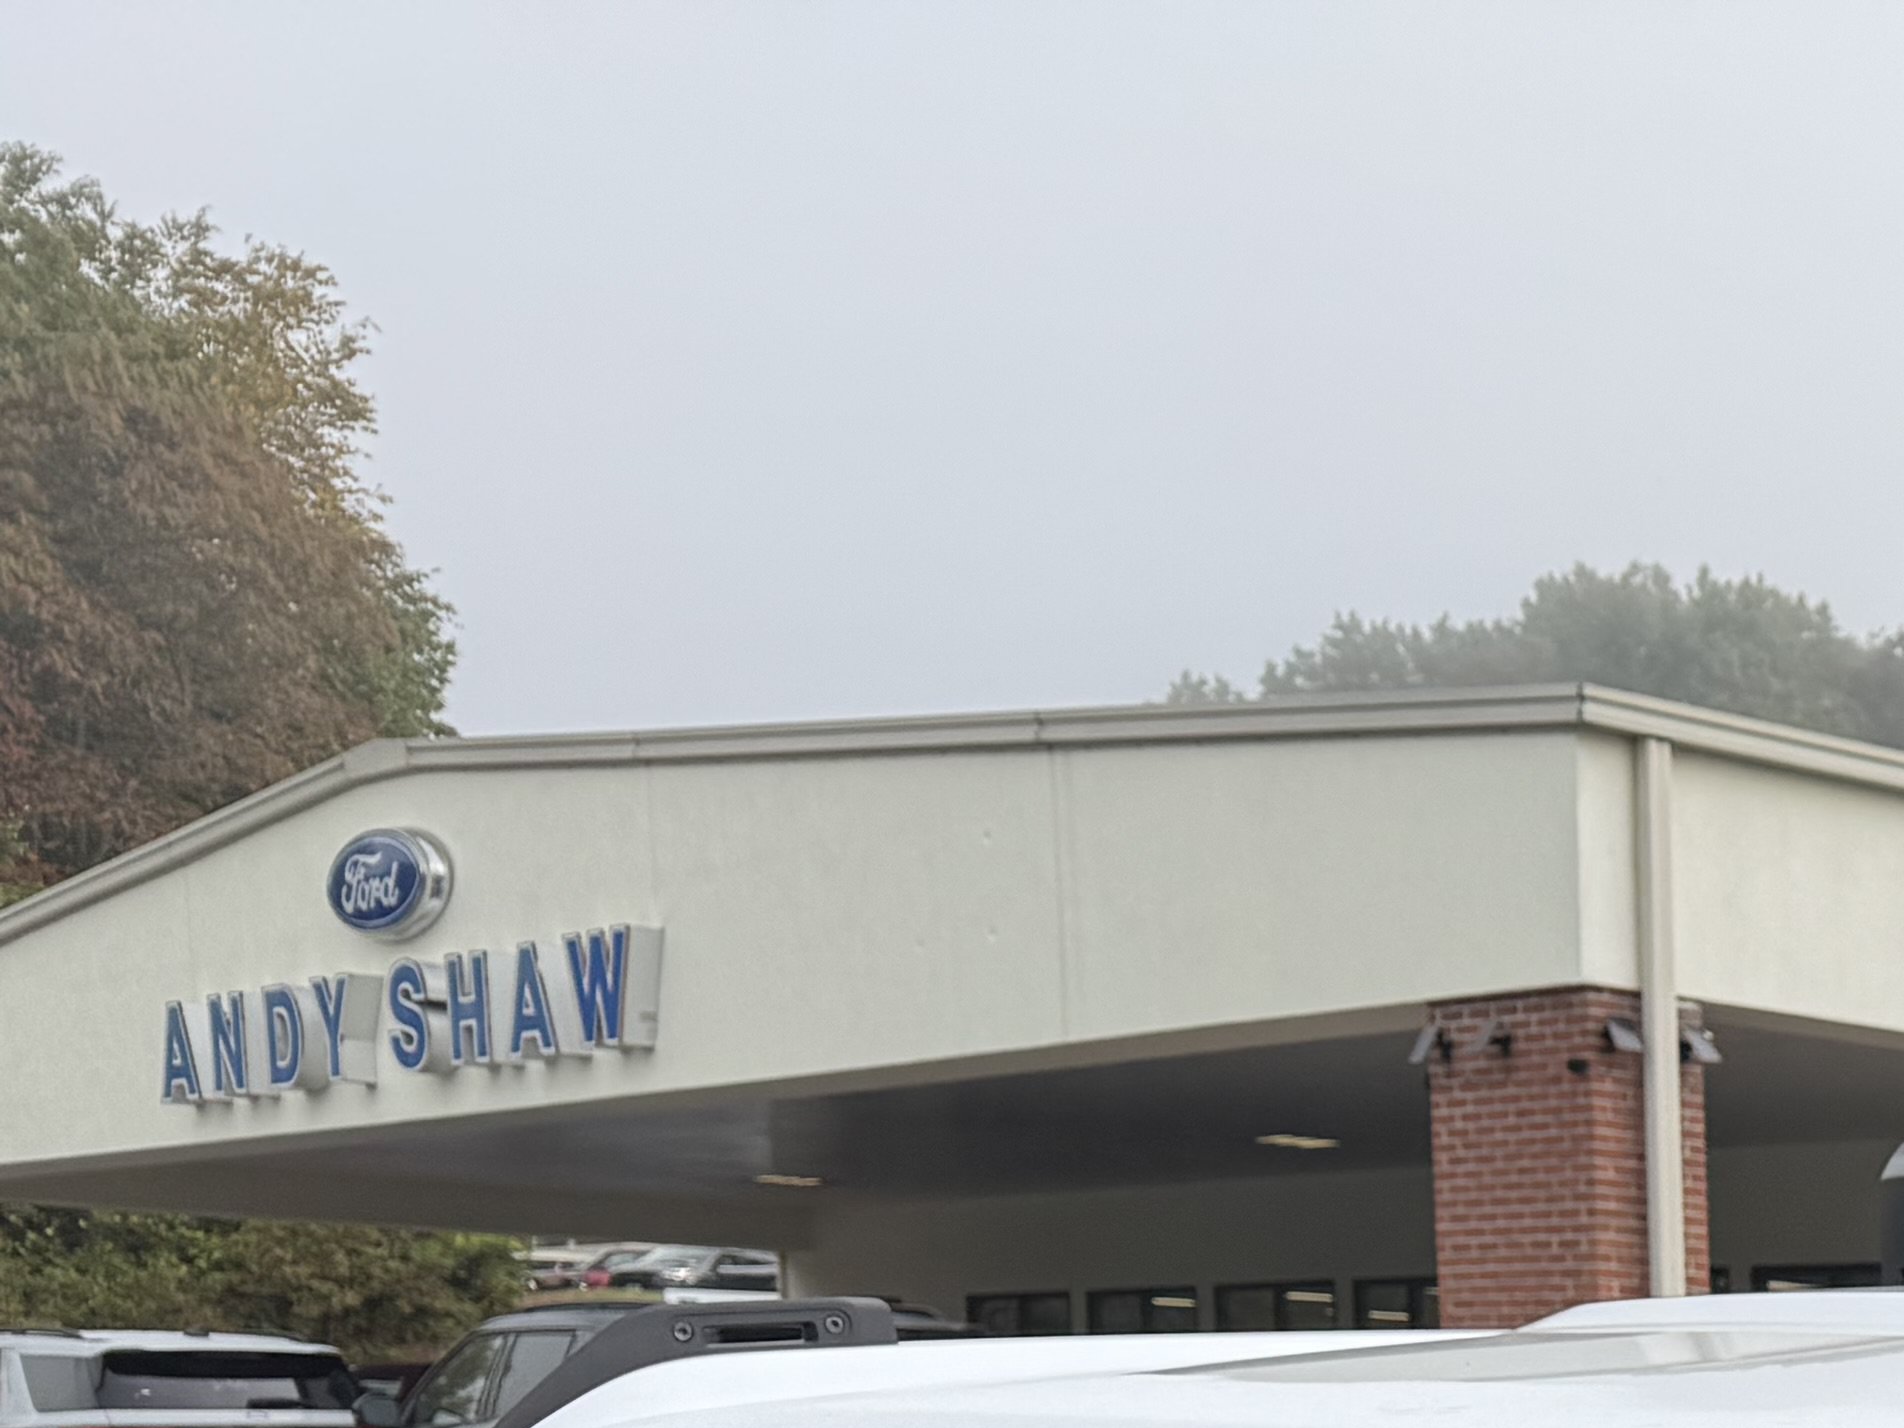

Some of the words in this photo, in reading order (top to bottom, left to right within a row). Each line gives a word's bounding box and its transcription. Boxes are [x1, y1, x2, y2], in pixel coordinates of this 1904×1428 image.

[339, 852, 400, 913] Ford
[160, 972, 350, 1105] ANDY
[387, 923, 634, 1074] SHAW
